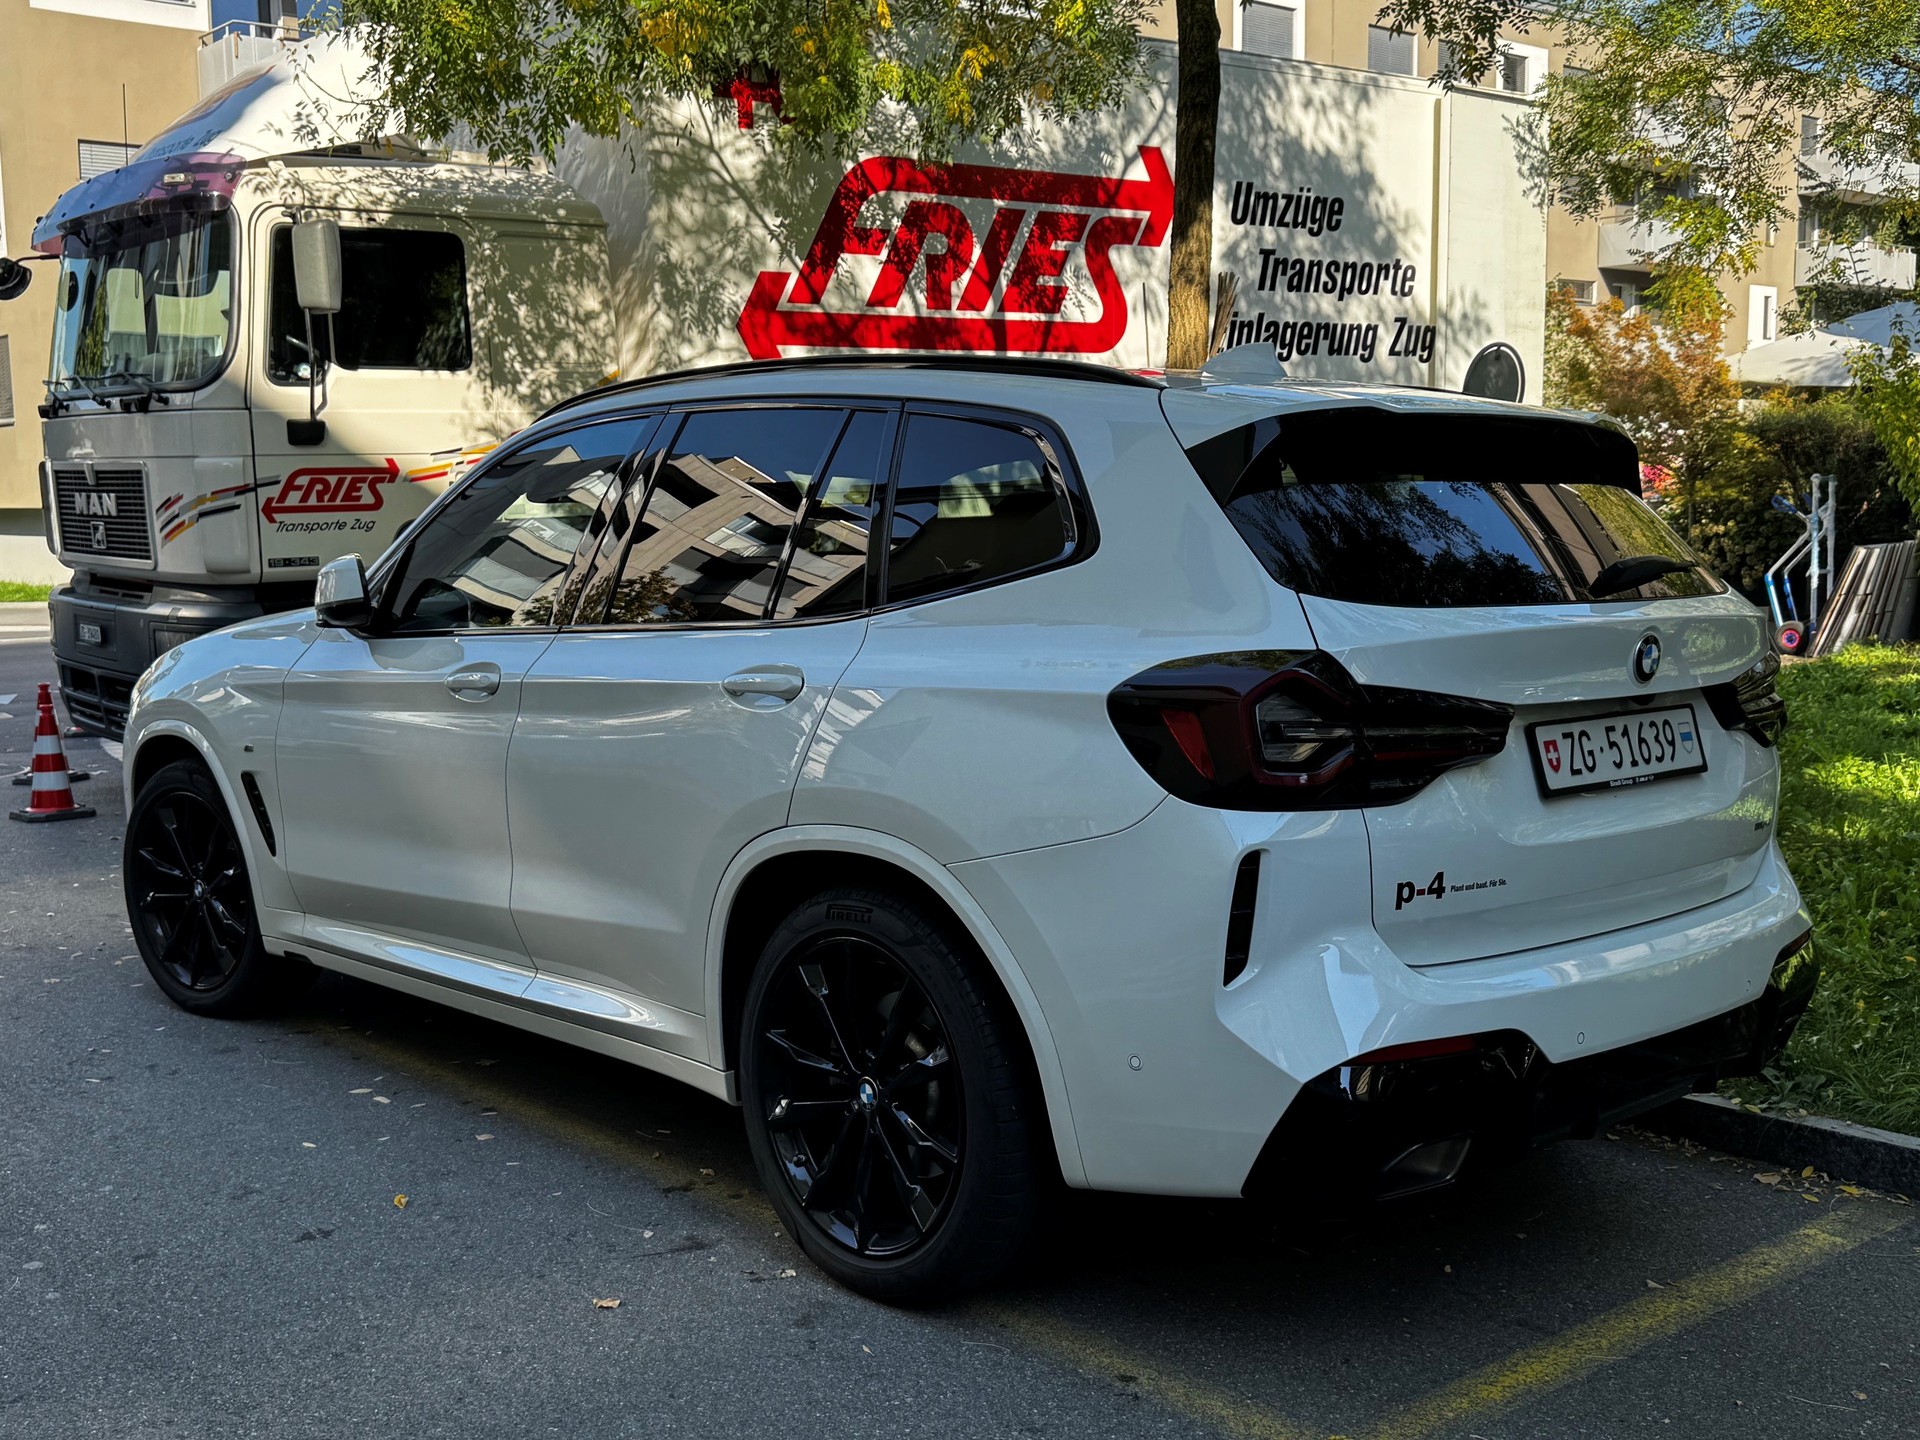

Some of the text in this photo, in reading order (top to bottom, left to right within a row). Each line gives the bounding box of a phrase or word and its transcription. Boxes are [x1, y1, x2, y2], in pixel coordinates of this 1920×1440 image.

[1231, 180, 1345, 237] Umzüge
[787, 156, 1143, 353] FRIES
[1257, 248, 1416, 301] Transporte
[1217, 311, 1437, 363] inlagerung Zug
[74, 492, 118, 516] MAN
[275, 467, 388, 514] FRIES
[276, 518, 376, 534] Transporte Zug
[825, 904, 873, 924] PIRELLI
[1395, 871, 1446, 910] p-4
[1465, 882, 1475, 891] und
[1489, 879, 1497, 888] Für
